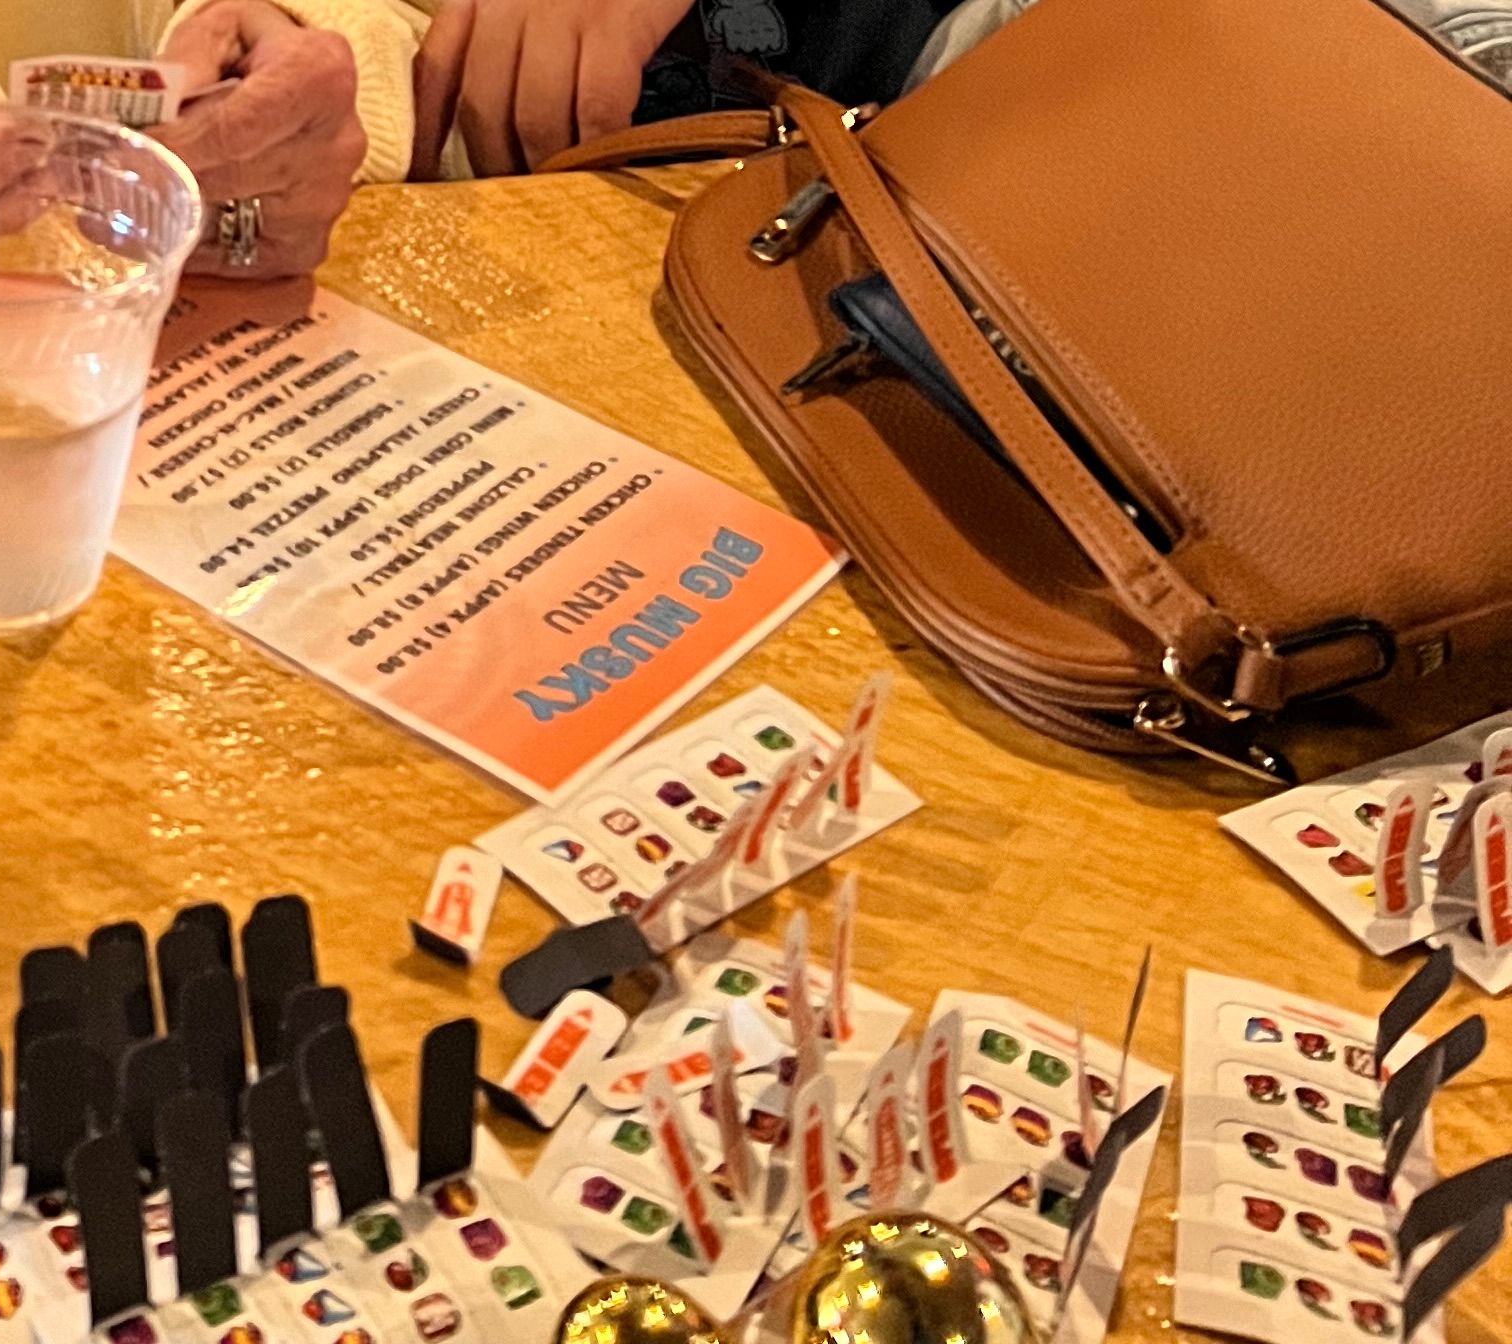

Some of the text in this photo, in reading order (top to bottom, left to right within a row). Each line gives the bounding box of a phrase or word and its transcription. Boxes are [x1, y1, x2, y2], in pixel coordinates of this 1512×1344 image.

[148, 354, 303, 448] BUFFALO CHICKEN
[303, 373, 374, 417] CRUNCH
[419, 387, 479, 426] CHEESY
[151, 394, 283, 477] MAC-N-CHEESE
[249, 415, 306, 450] ROLLS
[306, 403, 391, 457] EGGROLLS
[469, 406, 514, 433] MINI
[219, 448, 251, 469] (2)
[276, 455, 308, 476] (2)
[332, 424, 418, 483] JALAPENO
[422, 431, 472, 464] CORN
[374, 464, 425, 498] DOGS
[398, 461, 493, 527] PEPPERONI
[456, 466, 534, 521] CALZONE
[533, 461, 606, 511] CHICKEN
[579, 474, 651, 525] CHICKEN
[251, 486, 328, 536] PRETZEL
[317, 497, 374, 537] (APPX
[475, 511, 538, 554] WINGS
[364, 521, 458, 585] MEATBALL
[418, 553, 478, 596] (APPX
[505, 526, 583, 581] TENDERS
[447, 579, 507, 623] (APPX
[544, 560, 643, 633] MENU
[423, 621, 451, 638] 4)
[513, 527, 765, 722] BIG MUSKY
